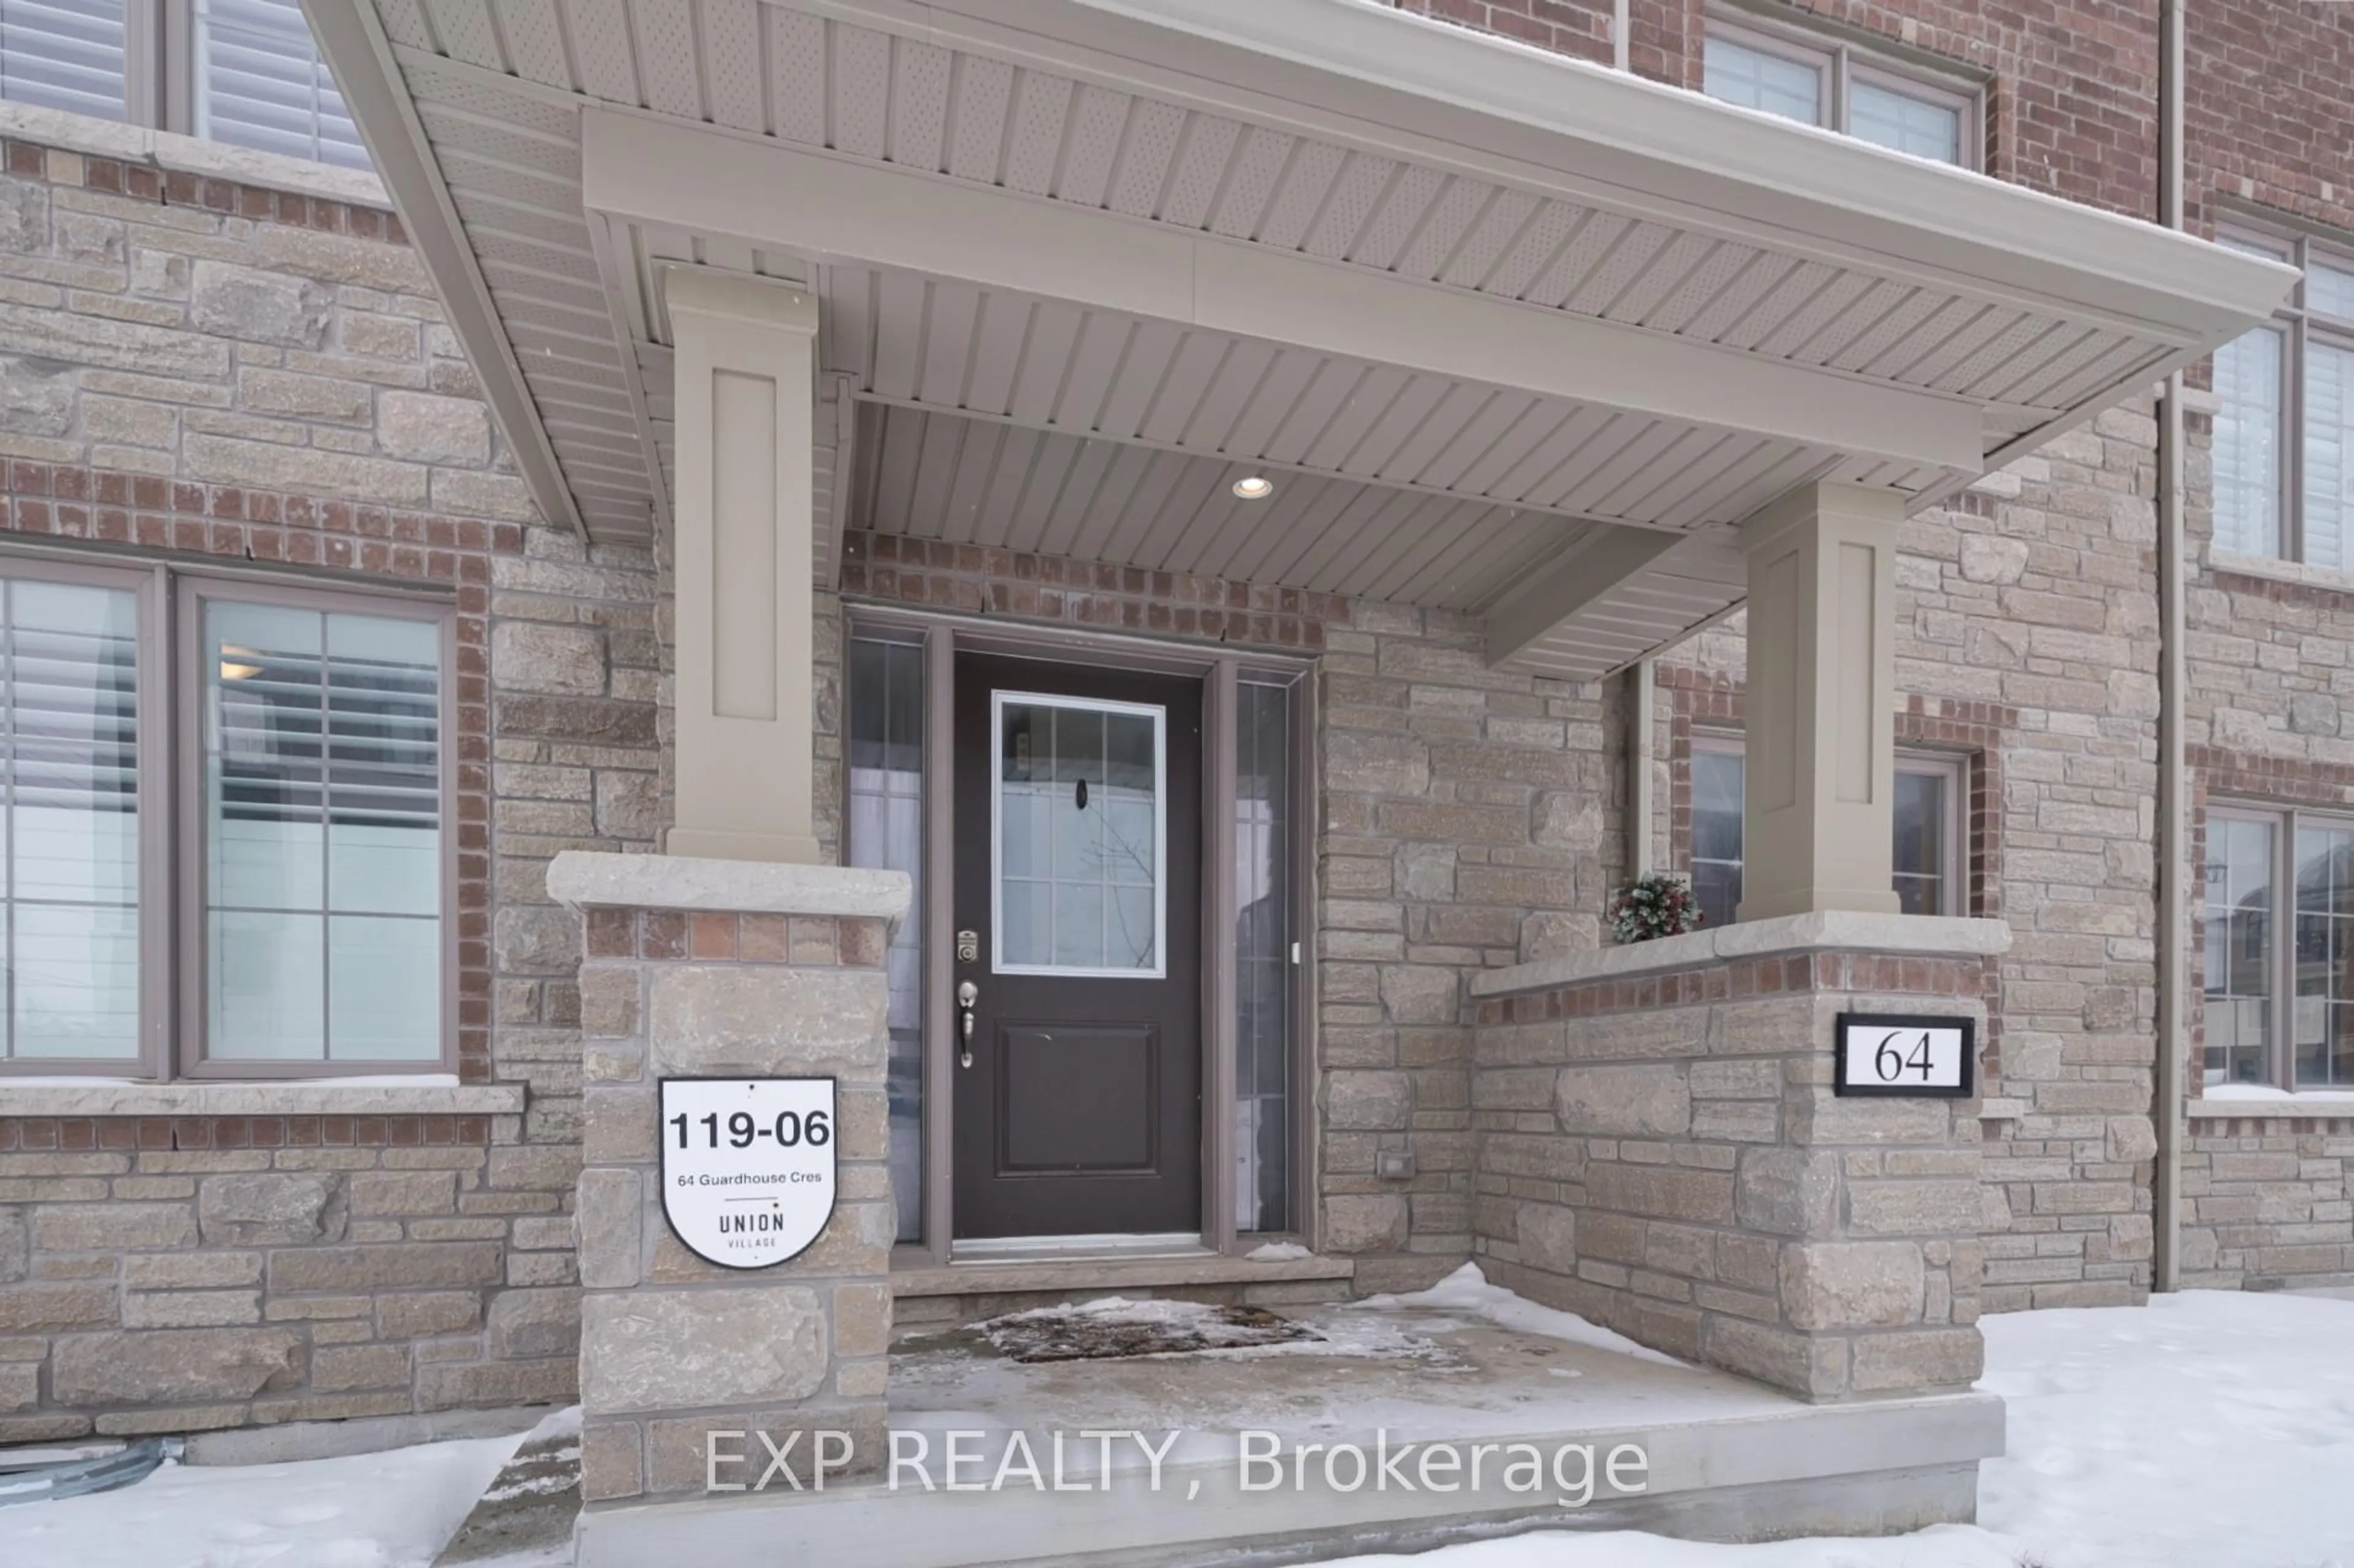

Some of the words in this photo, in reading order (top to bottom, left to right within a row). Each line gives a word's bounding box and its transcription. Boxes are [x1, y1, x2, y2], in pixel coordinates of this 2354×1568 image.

[1875, 1030, 1933, 1081] 64
[670, 1110, 829, 1149] 119-06
[677, 1175, 694, 1187] 64
[699, 1172, 786, 1186] Guardhouse
[790, 1171, 822, 1183] Cres
[720, 1214, 784, 1233] UNION
[728, 1238, 776, 1248] VILLAGE
